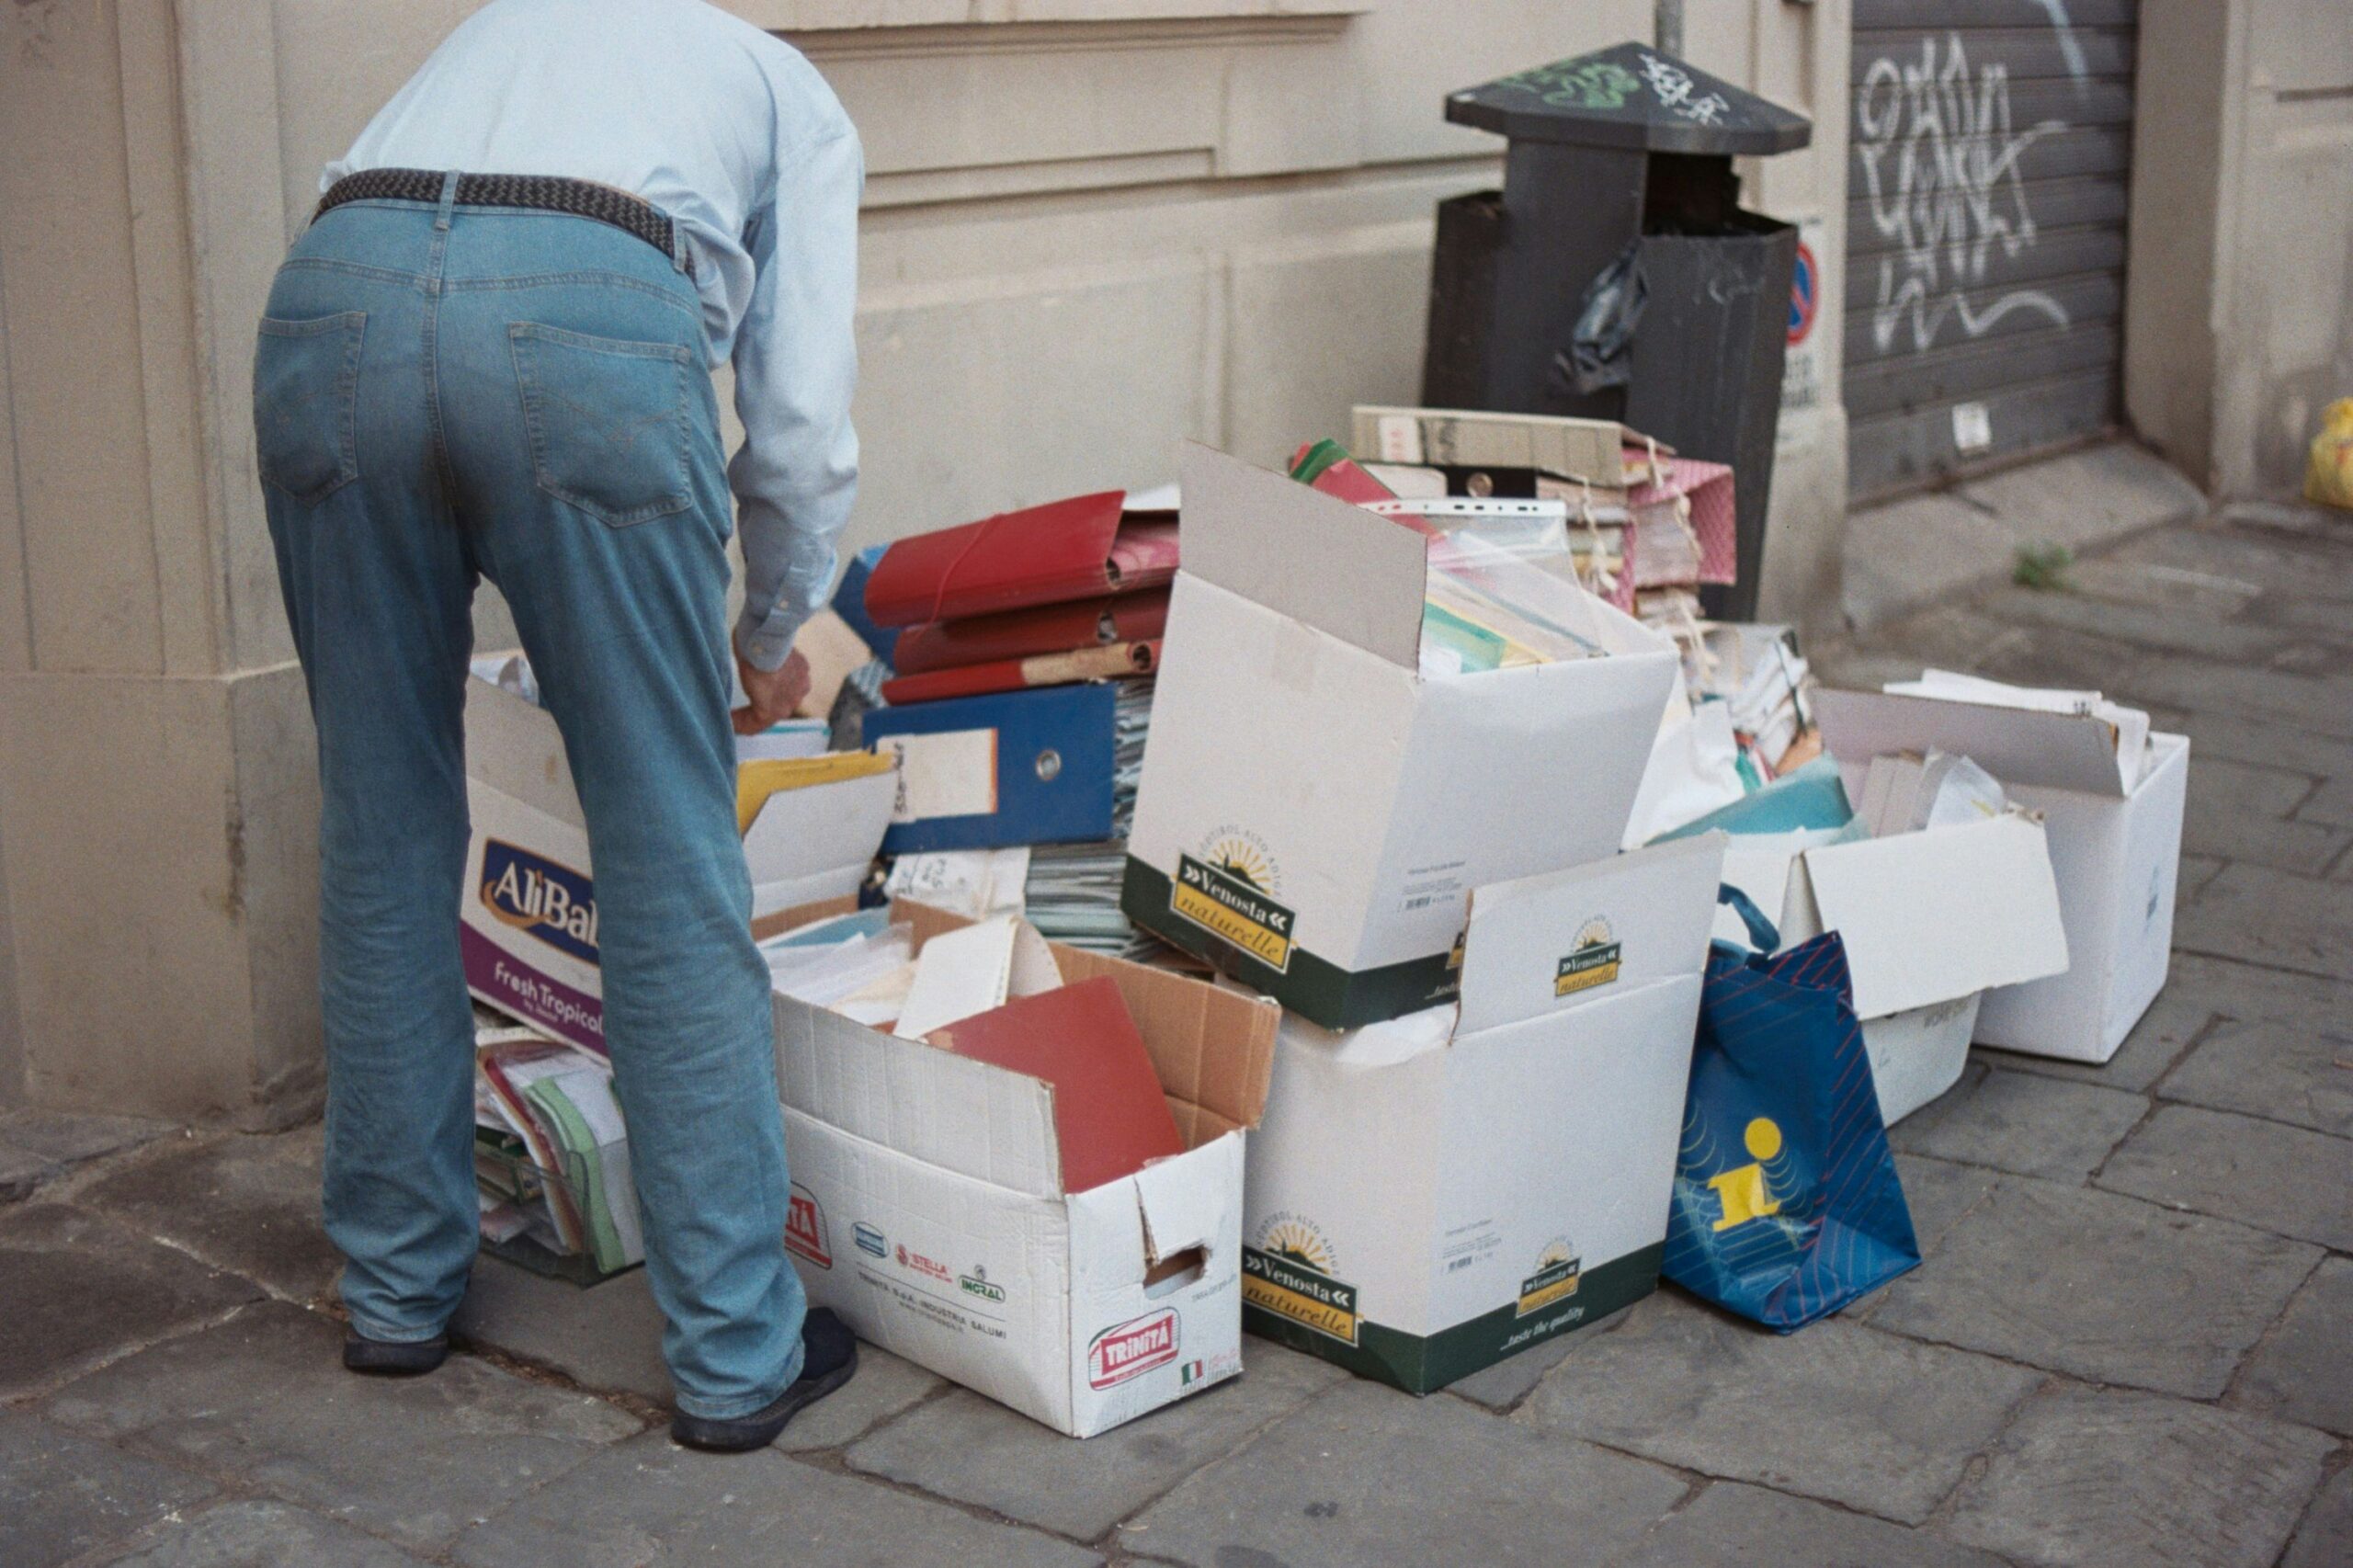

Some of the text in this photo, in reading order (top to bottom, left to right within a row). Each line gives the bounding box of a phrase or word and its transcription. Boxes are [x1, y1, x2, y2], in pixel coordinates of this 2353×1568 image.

[1201, 869, 1267, 924] Venosta
[1180, 896, 1279, 957] naturelle
[494, 960, 539, 999] Fresh
[1572, 953, 1607, 971] Venosta
[911, 1250, 949, 1275] STELLA
[1263, 1257, 1330, 1302] Venosta
[961, 1278, 1002, 1301] INGRAL
[920, 1300, 967, 1324] INDUSTRIA
[971, 1320, 1007, 1339] SALUMI
[1246, 1287, 1347, 1333] naturelle
[1533, 1320, 1550, 1336] the
[1549, 1306, 1586, 1332] quality
